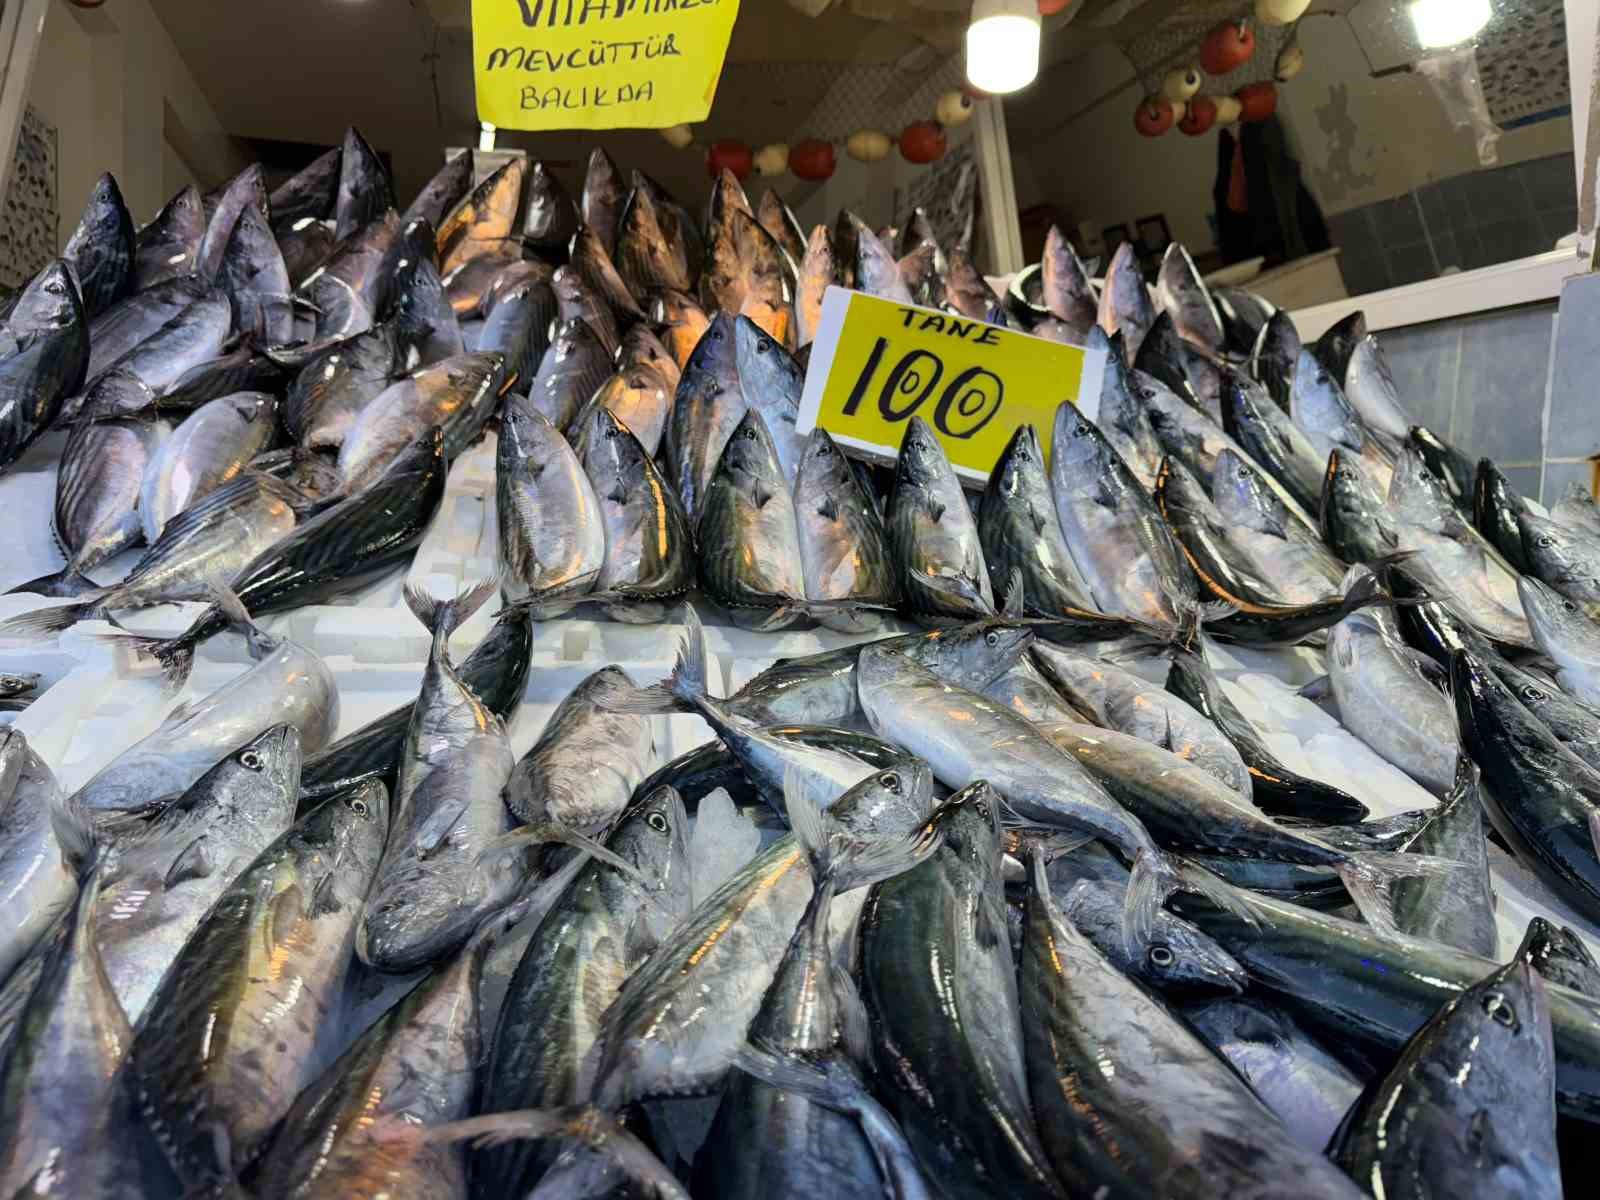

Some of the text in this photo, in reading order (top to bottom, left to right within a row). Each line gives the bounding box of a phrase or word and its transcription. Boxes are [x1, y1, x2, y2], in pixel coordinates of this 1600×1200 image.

[486, 33, 680, 71] MEVCÜTTÜR
[898, 308, 1001, 345] TANE
[842, 337, 1004, 439] 100
